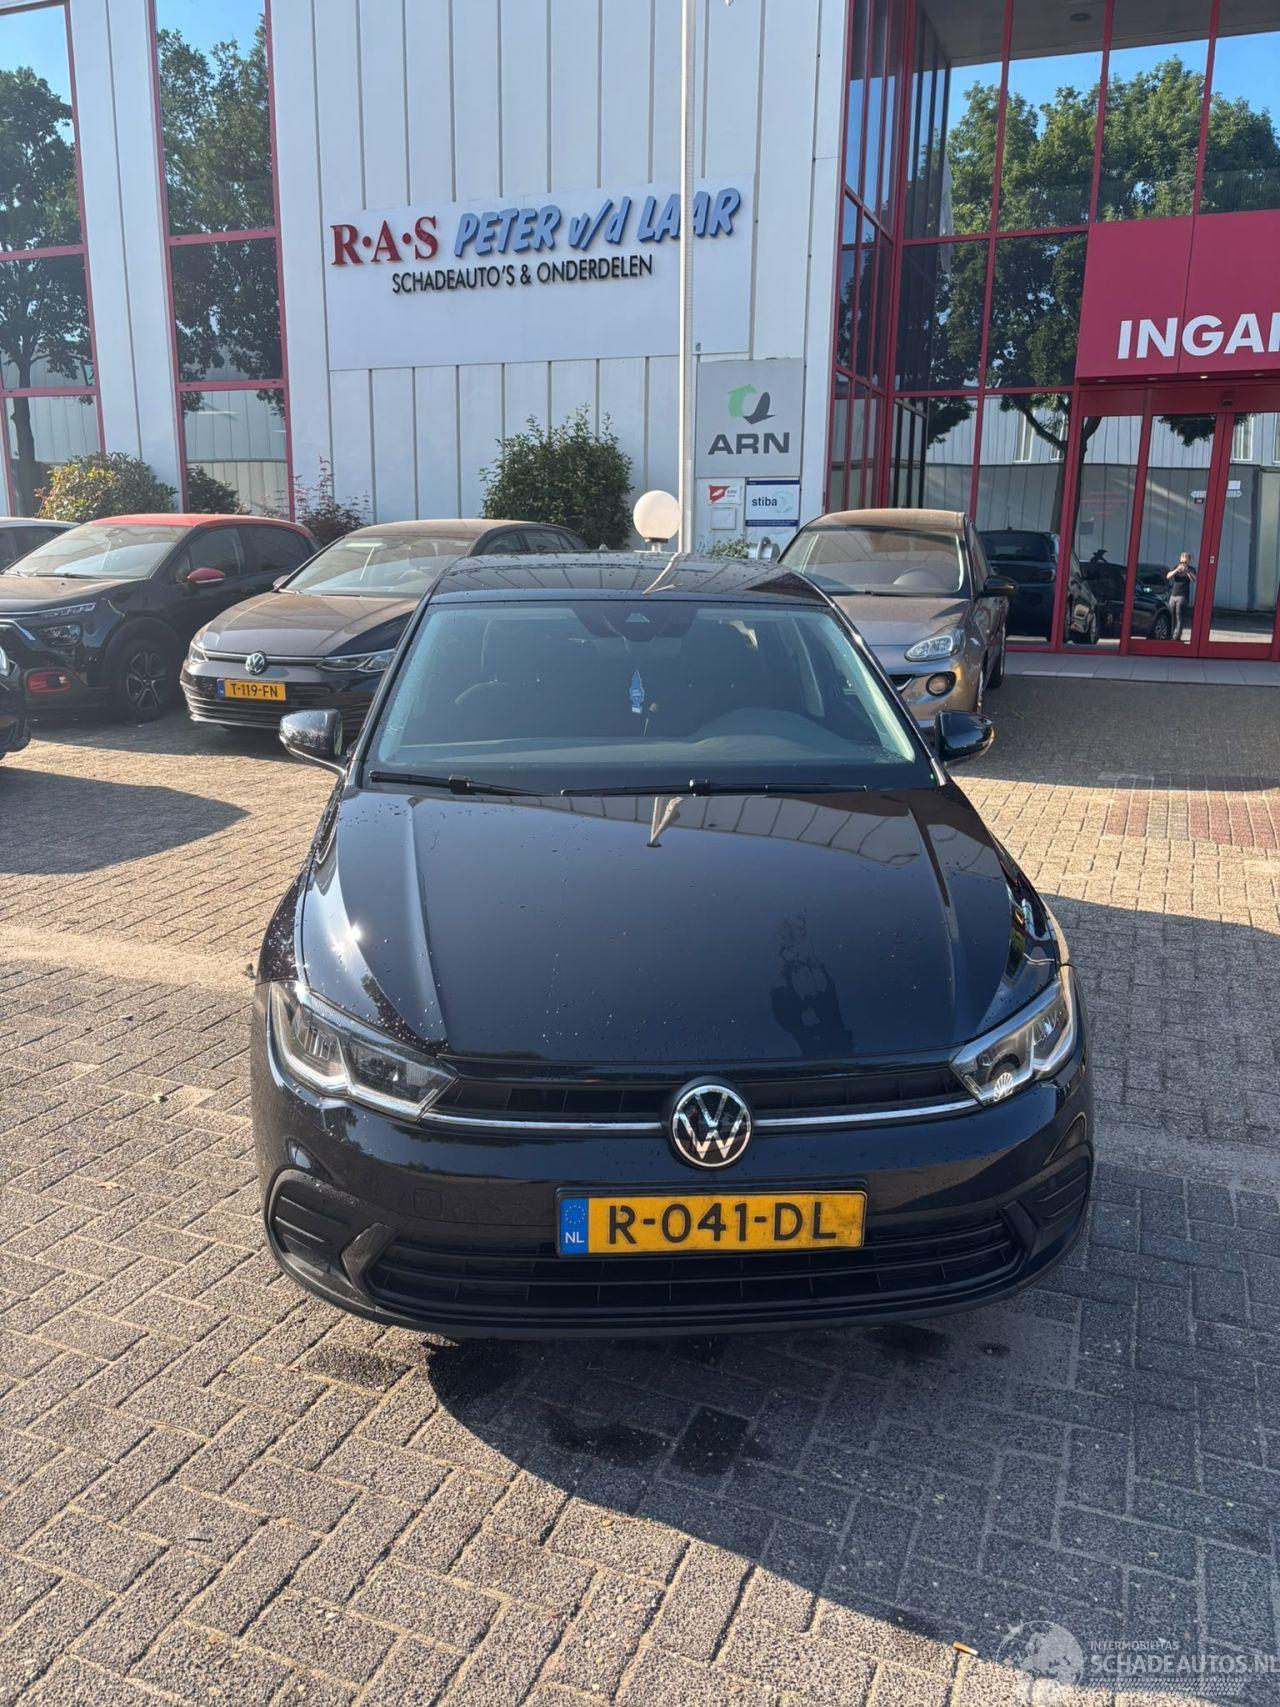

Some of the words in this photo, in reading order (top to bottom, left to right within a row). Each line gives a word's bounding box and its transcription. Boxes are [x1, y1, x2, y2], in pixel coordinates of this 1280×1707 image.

[453, 204, 561, 258] PETER
[569, 197, 632, 251] v/d
[392, 264, 515, 294] SCHADEAUTO'S
[520, 263, 532, 285] &
[537, 255, 653, 284] ONDERDELEN
[708, 432, 790, 456] ARN
[751, 496, 778, 507] stiba
[230, 683, 279, 698] T-119-FN
[564, 1230, 585, 1244] NL
[608, 1201, 838, 1245] R-041-DL
